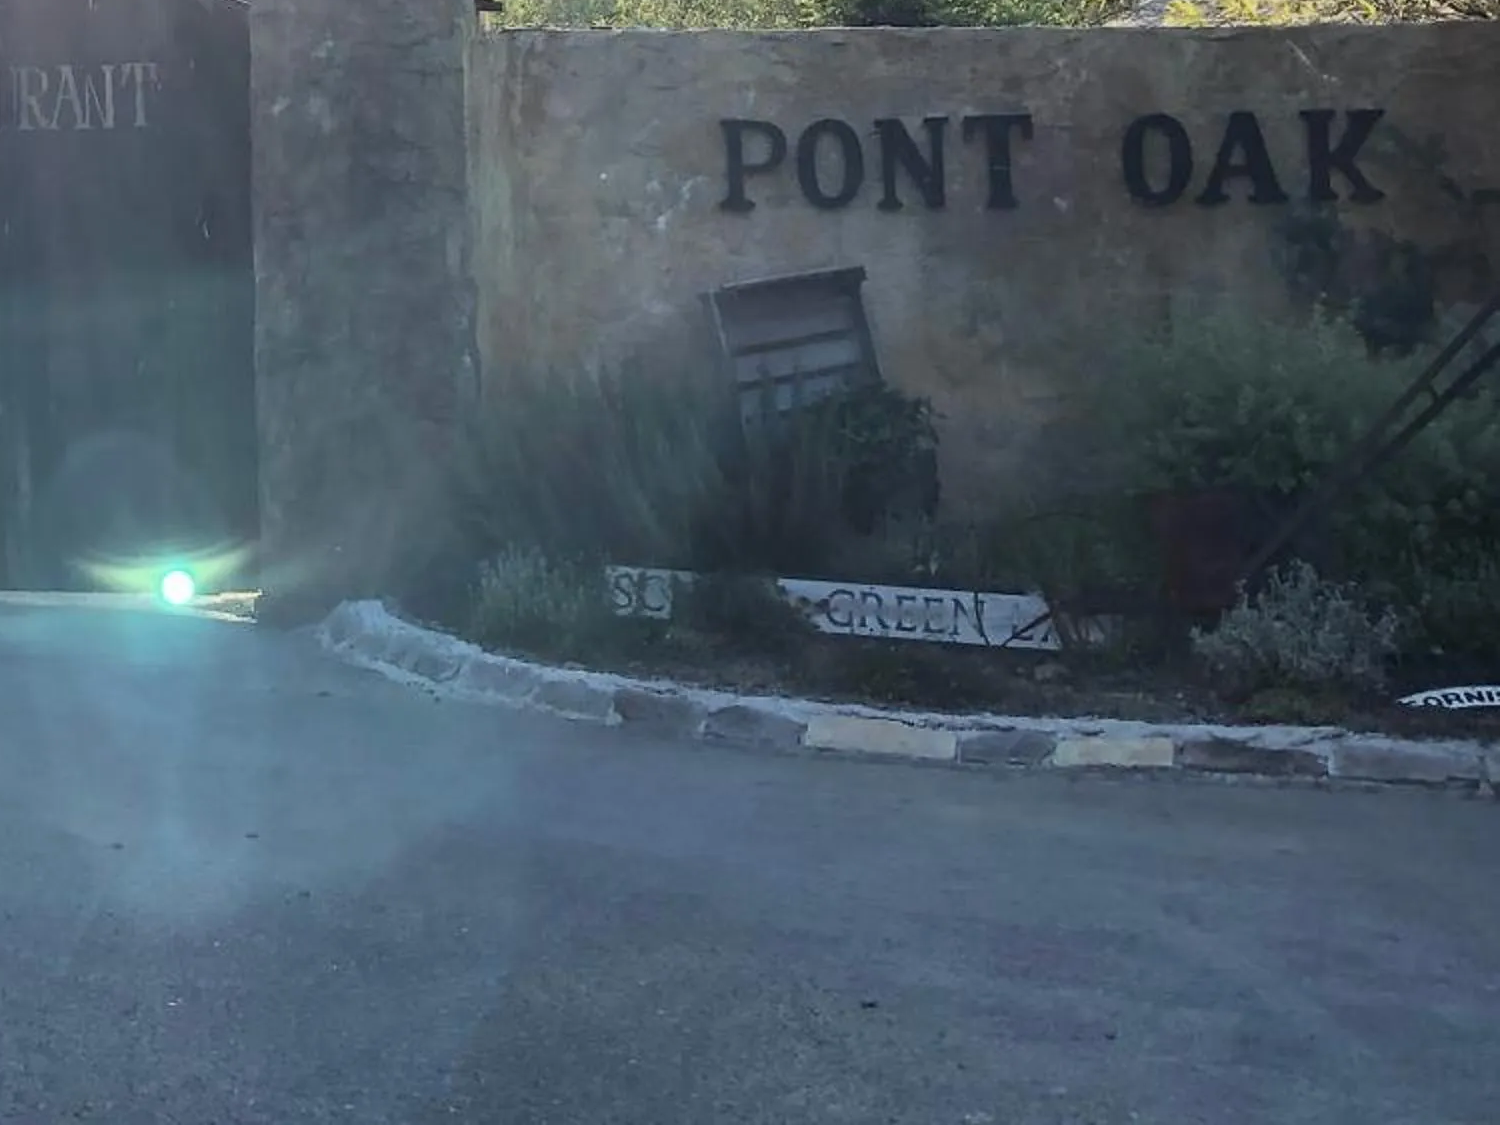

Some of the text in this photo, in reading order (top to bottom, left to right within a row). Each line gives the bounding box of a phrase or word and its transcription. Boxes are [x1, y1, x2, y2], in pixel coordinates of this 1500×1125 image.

[720, 108, 1386, 212] PONT OAK
[826, 587, 988, 636] GREEN
